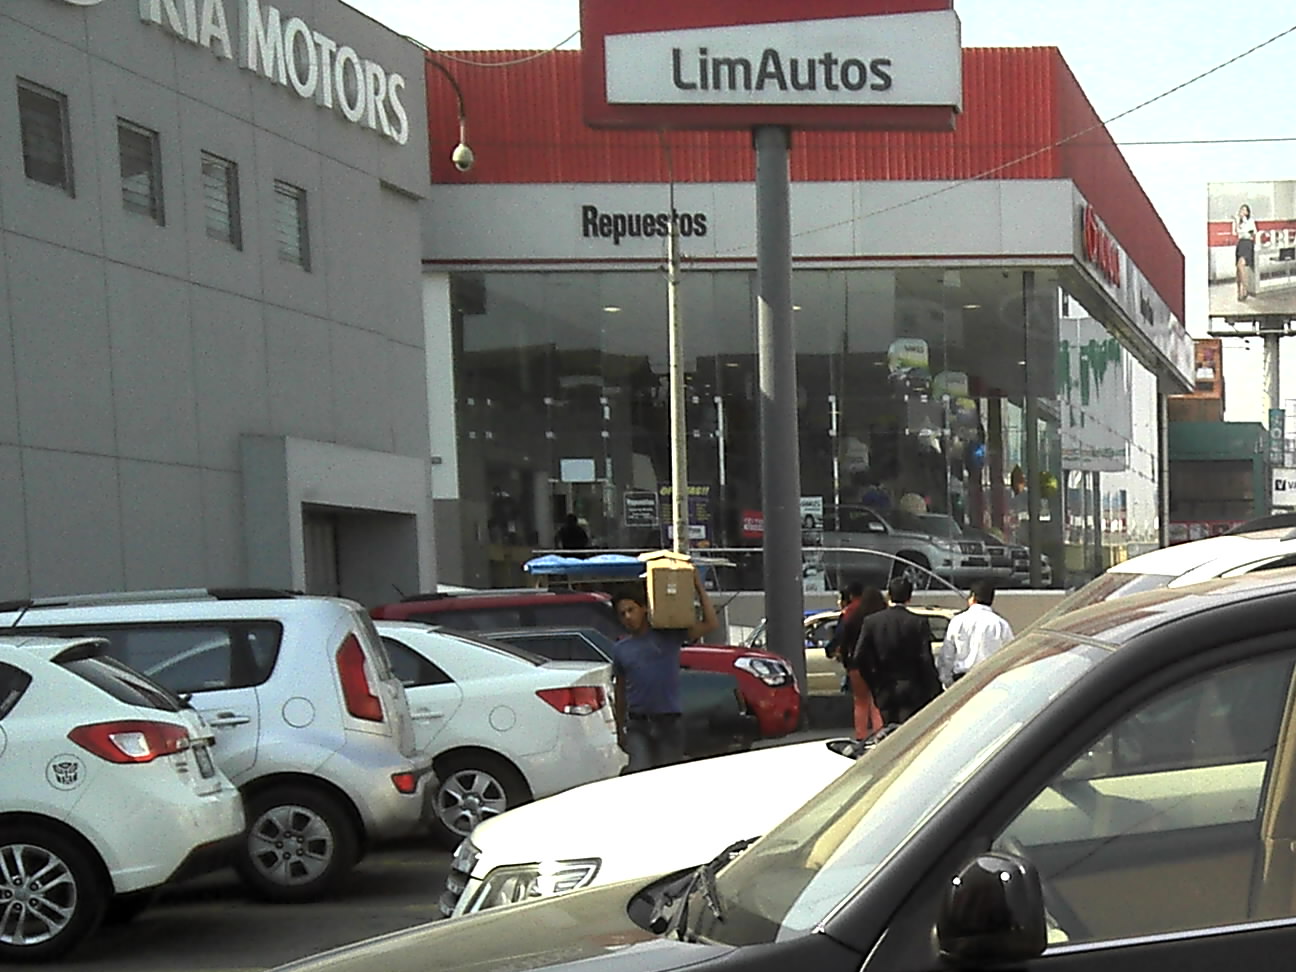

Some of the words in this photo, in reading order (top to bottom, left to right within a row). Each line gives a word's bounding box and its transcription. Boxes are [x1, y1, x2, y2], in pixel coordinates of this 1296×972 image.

[239, 0, 409, 145] MOTORS
[671, 47, 893, 91] LimAutos
[582, 205, 708, 245] Repuestos
